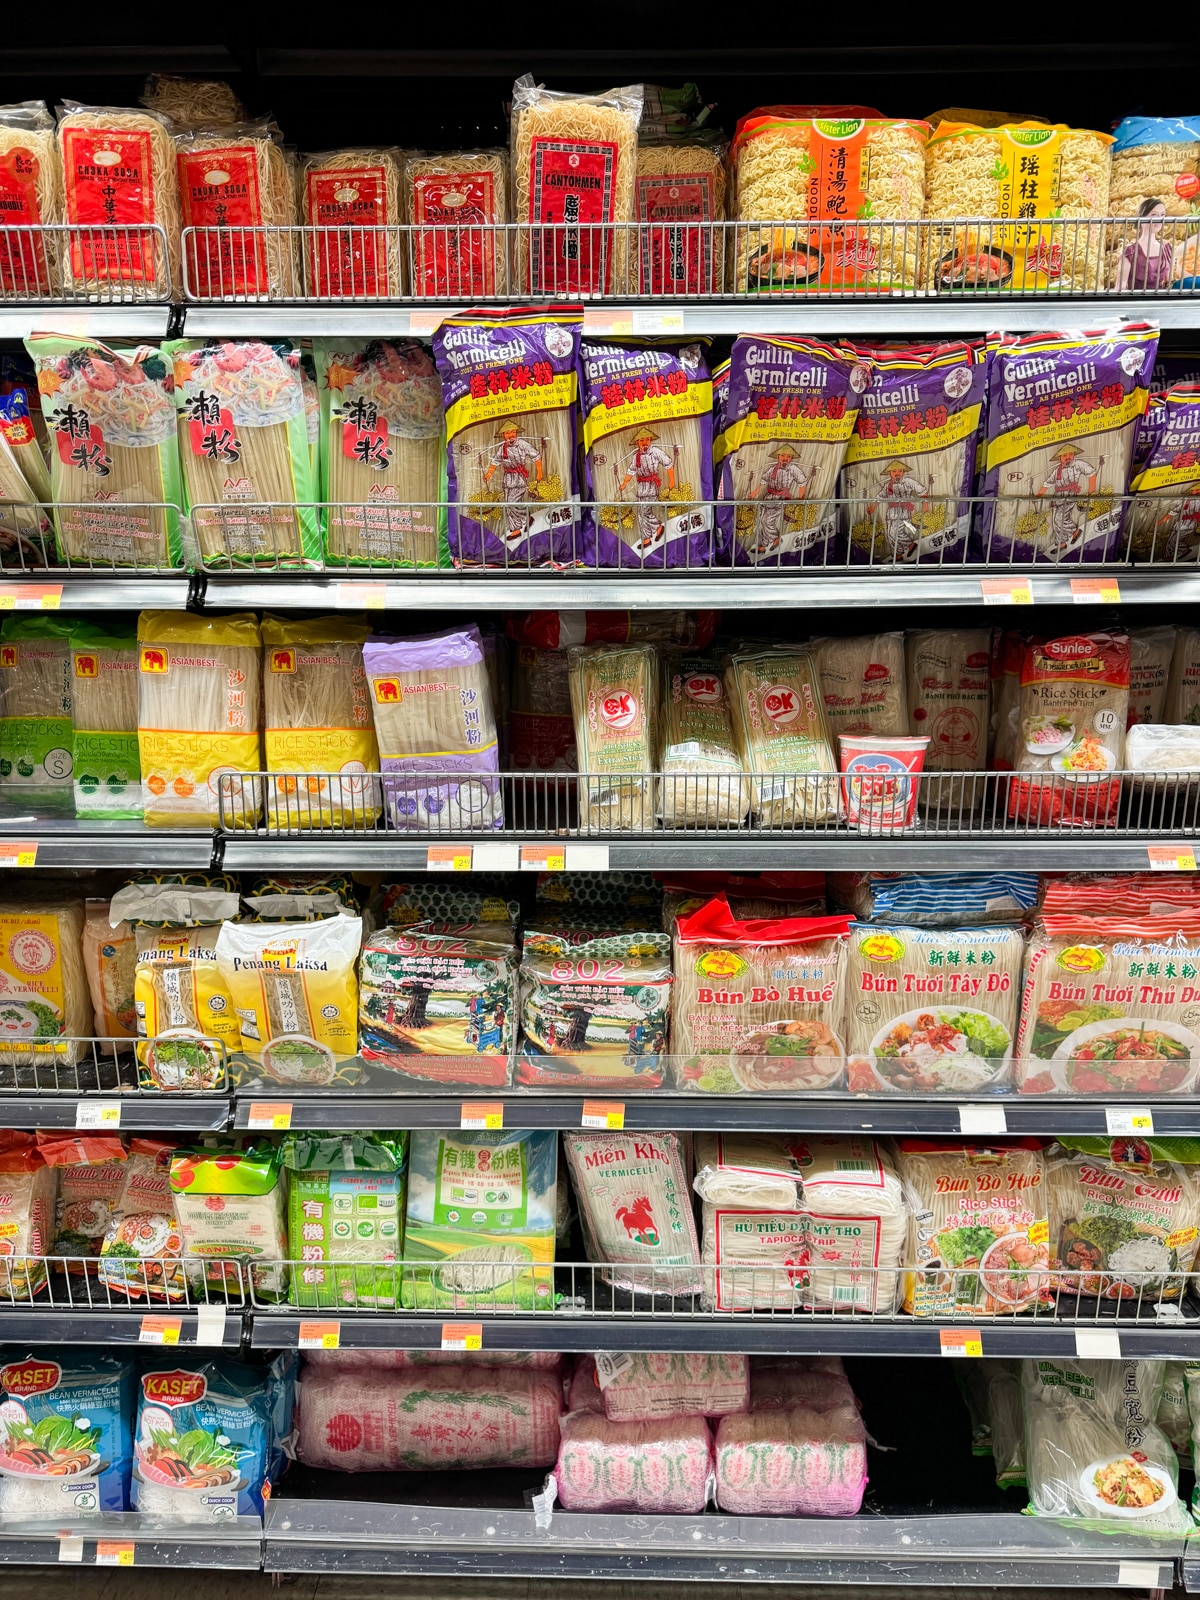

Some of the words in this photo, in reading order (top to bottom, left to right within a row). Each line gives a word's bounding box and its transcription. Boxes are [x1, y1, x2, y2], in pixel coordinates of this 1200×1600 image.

[545, 174, 601, 189] CANTONMEN
[650, 204, 700, 218] CANTONMEN
[809, 178, 818, 234] NOODLS
[443, 329, 488, 350] Guilin
[447, 338, 526, 369] Vermicelli
[746, 346, 793, 365] Guilin
[470, 361, 553, 399] 桂林米粉
[622, 370, 642, 379] FRESH
[744, 367, 827, 387] Vermicelli
[1004, 361, 1056, 382] Guilin
[601, 370, 687, 409] 桂林米粉
[1004, 362, 1097, 402] Vermicelli
[1015, 399, 1034, 408] JUST
[1051, 390, 1074, 400] FRESH
[1077, 384, 1092, 392] ONE
[757, 395, 847, 420] 桂林米粉
[1026, 383, 1125, 430] 桂林米粉
[857, 405, 947, 440] 桂林米粉
[1051, 643, 1092, 654] Sunlee
[171, 657, 195, 666] ASIAN
[196, 659, 217, 667] BEST
[298, 656, 321, 664] ASIAN
[322, 657, 341, 665] BEST
[404, 685, 427, 694] ASIAN
[429, 683, 448, 692] BEST
[1041, 688, 1067, 699] Rice
[1069, 688, 1100, 699] Stick
[228, 669, 246, 727] 沙河粉
[460, 688, 482, 744] 沙河粉
[1100, 713, 1114, 723] 10
[22, 724, 64, 736] STICKS
[680, 720, 703, 728] Extra
[706, 723, 730, 732] Sticky
[76, 738, 107, 750] RICE
[143, 737, 175, 750] RICE
[178, 739, 229, 753] STICKS
[274, 736, 306, 748] RICE
[310, 735, 357, 748] STICKS
[624, 753, 643, 763] Stick
[765, 750, 789, 760] Extra
[792, 746, 817, 756] Sticky
[53, 760, 64, 775] S
[179, 946, 217, 961] Laksa
[396, 936, 468, 954] 802
[1113, 944, 1143, 956] Rice
[233, 956, 280, 972] Penang
[286, 956, 328, 971] Laksa
[928, 950, 996, 967] 新鮮米粉
[551, 959, 625, 980] 802
[1128, 962, 1198, 979] 新鮮米粉
[861, 972, 898, 992] Bún
[903, 973, 944, 992] Tươi
[949, 972, 982, 996] Tây
[986, 972, 1010, 992] Đô
[697, 987, 744, 1005] Bún
[751, 986, 780, 1003] Bò
[788, 981, 835, 1002] Huế
[1048, 983, 1086, 1000] Bún
[1092, 984, 1134, 1002] Tươi
[1139, 985, 1176, 1005] Thủ
[445, 1147, 476, 1169] 有機
[491, 1148, 520, 1170] 粉條
[584, 1143, 626, 1171] Miến
[634, 1143, 670, 1165] Khô
[65, 1167, 97, 1179] Bánh
[599, 1165, 658, 1178] VERMICELLI
[132, 1174, 166, 1191] Bánh
[935, 1175, 970, 1193] Bún
[976, 1174, 1001, 1193] Bò
[1007, 1168, 1041, 1191] Huế
[1079, 1166, 1125, 1190] Bún
[1134, 1182, 1183, 1203] Tươi
[959, 1198, 987, 1210] Rice
[990, 1196, 1022, 1209] Stick
[1087, 1190, 1112, 1203] Rice
[1116, 1197, 1172, 1216] Vermicelli
[735, 1220, 752, 1233] HỦ
[757, 1218, 786, 1233] TIẾU
[814, 1222, 831, 1235] MỸ
[836, 1227, 861, 1236] THO
[946, 1210, 1035, 1227] 特級順化米粉
[302, 1199, 325, 1284] 有機粉條
[760, 1235, 804, 1245] TAPIOCA
[806, 1235, 836, 1246] STRIP
[2, 1368, 55, 1387] KASET
[1066, 1371, 1094, 1387] BEAN
[50, 1392, 71, 1400] BEAN
[72, 1386, 119, 1398] VERMICELLI
[146, 1378, 202, 1396] KASET
[195, 1404, 216, 1412] BEAN
[217, 1405, 256, 1417] VERMICELLI
